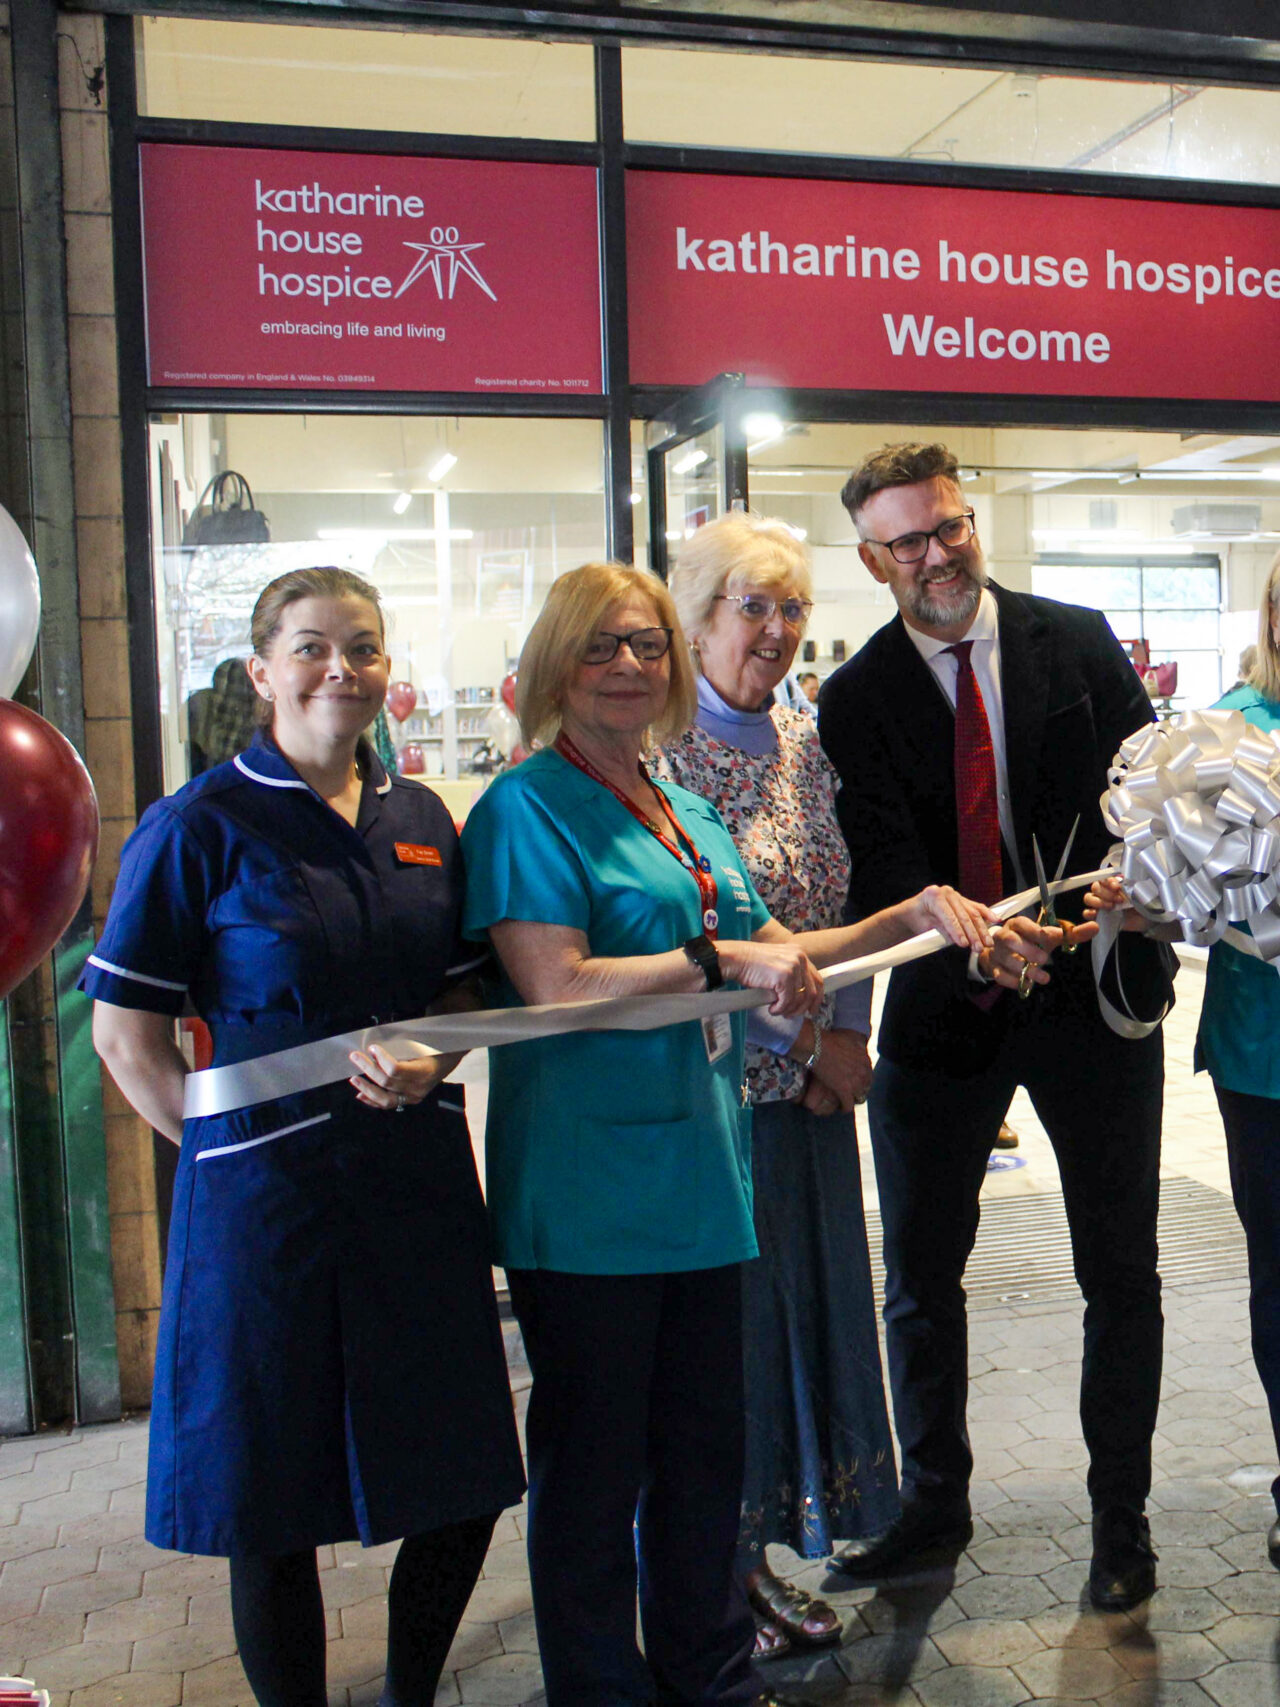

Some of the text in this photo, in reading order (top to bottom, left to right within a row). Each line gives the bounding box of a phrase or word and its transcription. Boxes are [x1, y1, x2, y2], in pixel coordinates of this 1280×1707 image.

[255, 179, 425, 218] katharine
[256, 219, 363, 256] house
[676, 227, 921, 281] katharine
[938, 239, 1089, 289] house
[258, 263, 392, 307] hospice
[260, 320, 446, 342] embracing life and living
[882, 313, 1112, 364] Welcome
[164, 370, 208, 380] Registered
[209, 373, 245, 382] company
[247, 373, 255, 381] in
[256, 372, 289, 382] England
[299, 373, 322, 383] Wales
[474, 376, 518, 386] Registered
[519, 377, 546, 388] charity
